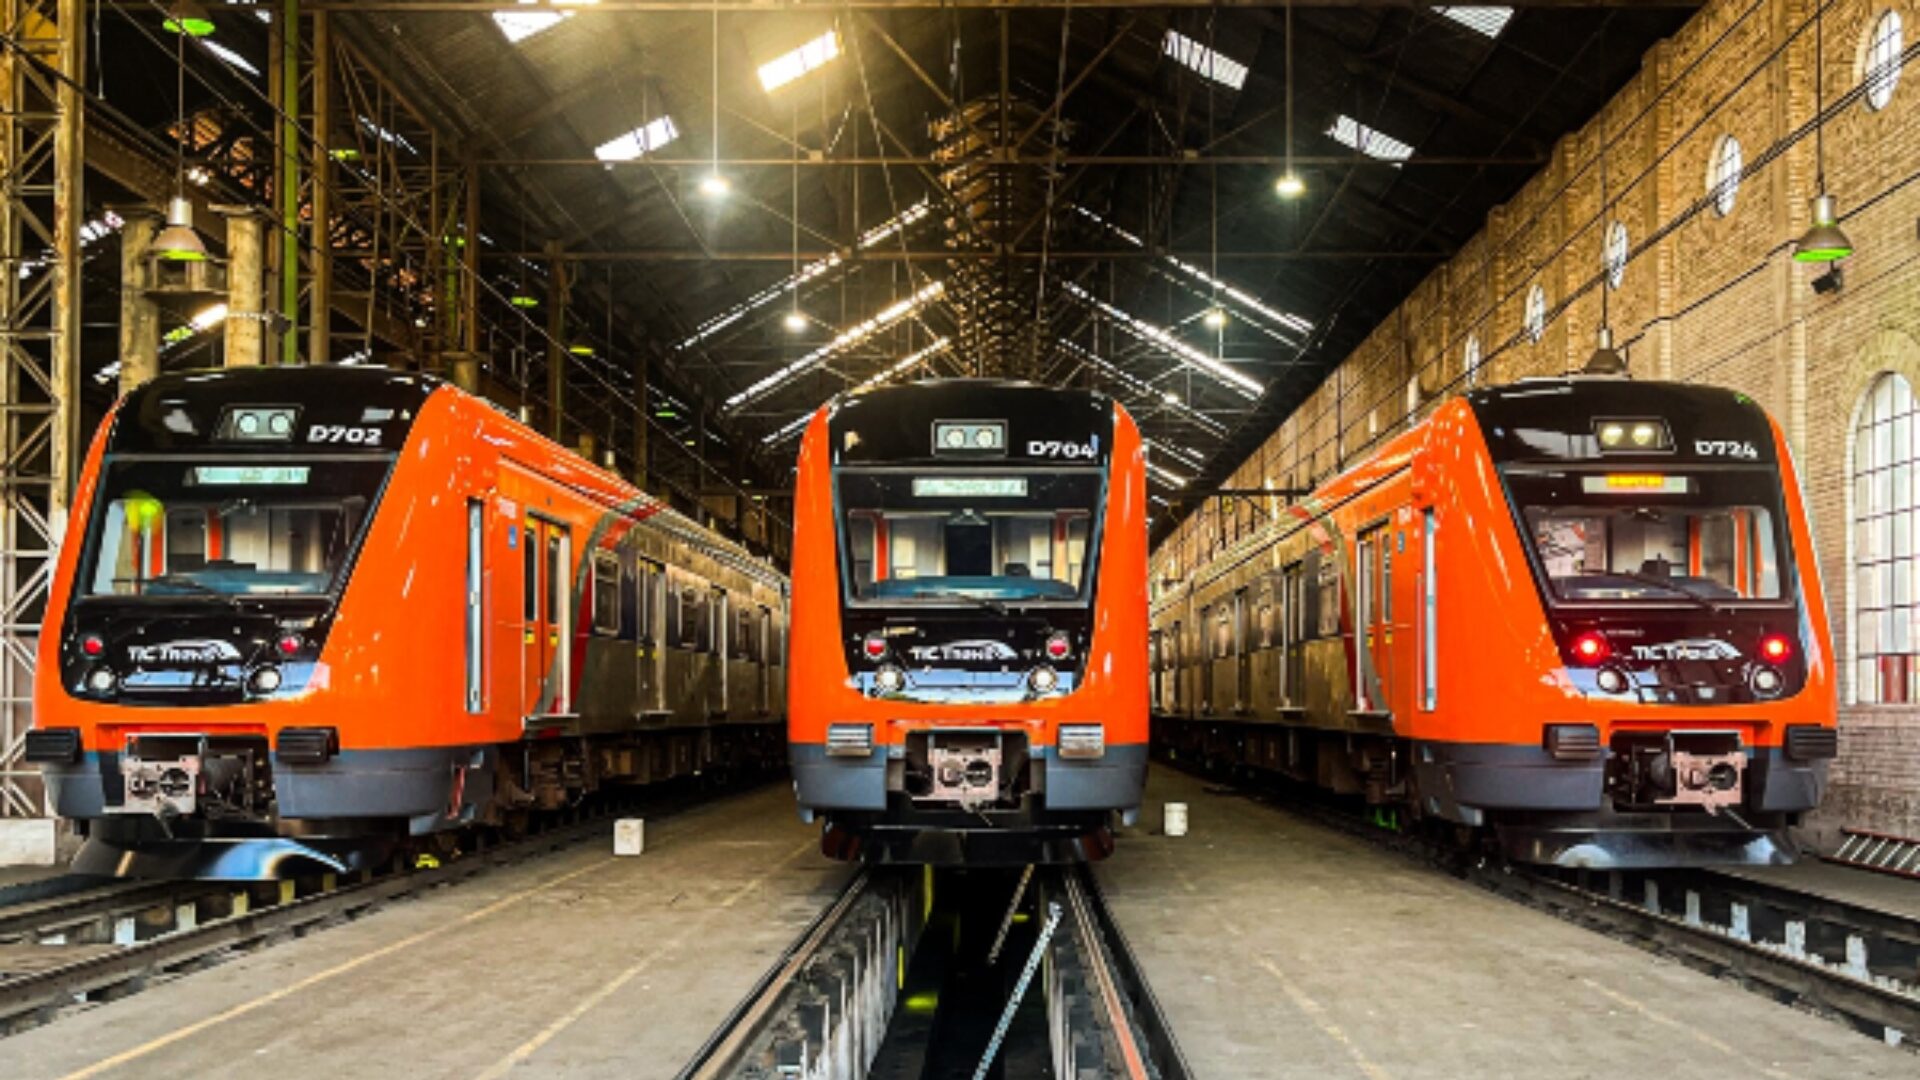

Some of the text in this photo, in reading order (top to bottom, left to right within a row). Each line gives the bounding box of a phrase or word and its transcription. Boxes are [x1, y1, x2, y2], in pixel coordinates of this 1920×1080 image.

[307, 424, 382, 445] D702
[1027, 440, 1094, 458] D704
[1695, 440, 1759, 459] D724
[127, 645, 157, 662] TIC
[911, 645, 940, 661] TIC
[1632, 645, 1663, 660] TIC
